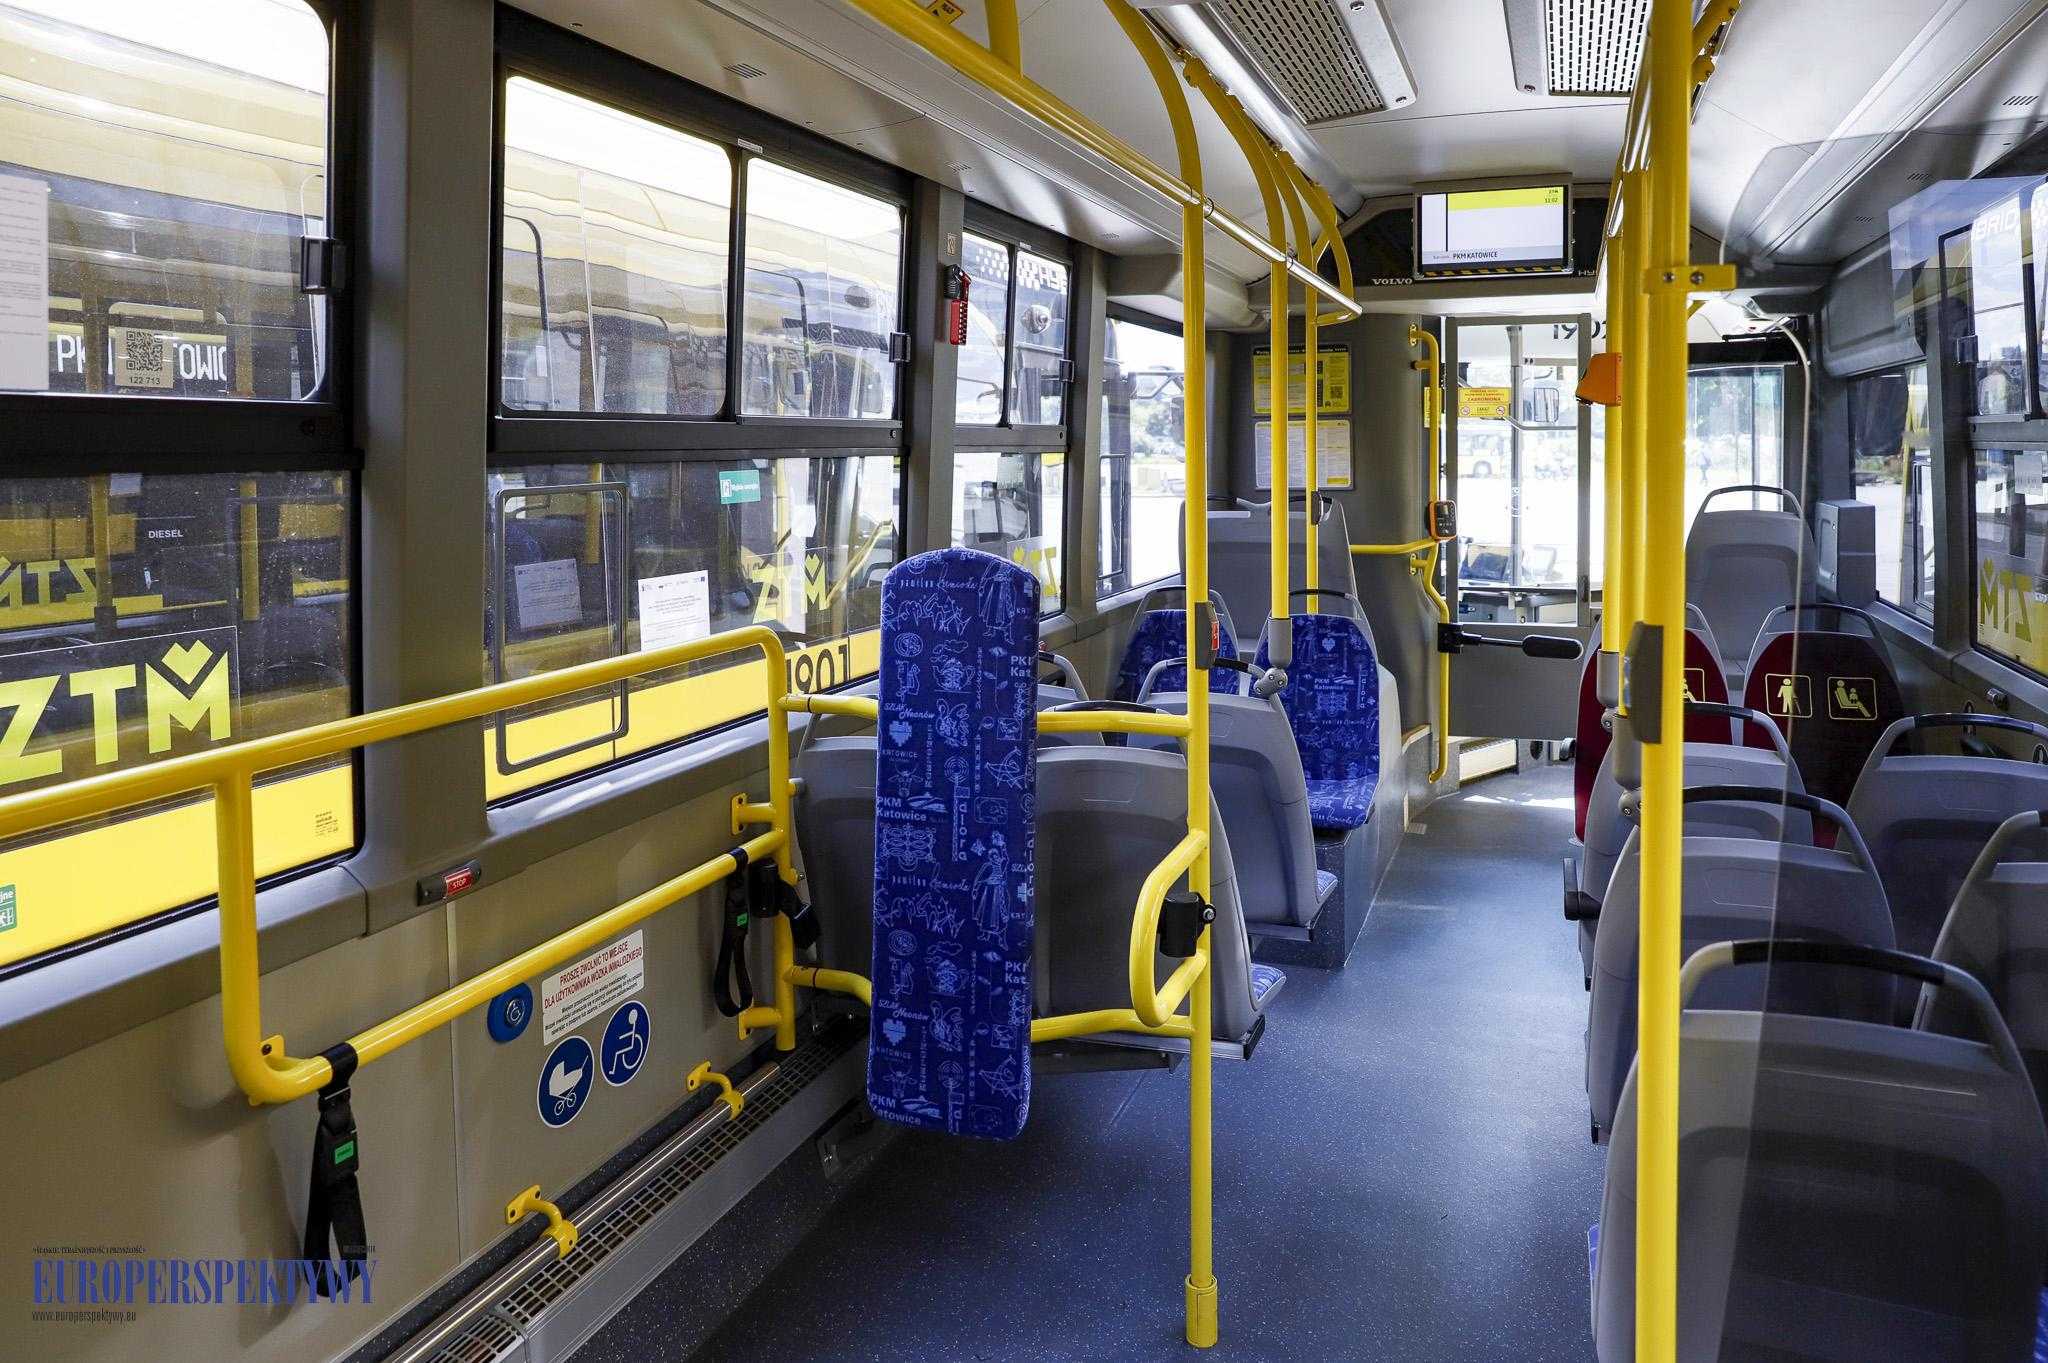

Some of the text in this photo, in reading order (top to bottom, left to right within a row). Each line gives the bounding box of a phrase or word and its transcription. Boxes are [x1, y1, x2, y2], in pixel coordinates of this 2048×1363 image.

[1452, 252, 1466, 260] PKM
[1467, 251, 1498, 260] KATOWICE
[1372, 278, 1413, 286] VOLVO
[148, 529, 184, 539] DIESEL
[0, 640, 231, 785] ZTM
[876, 796, 902, 809] PKM
[876, 808, 927, 823] Katowice
